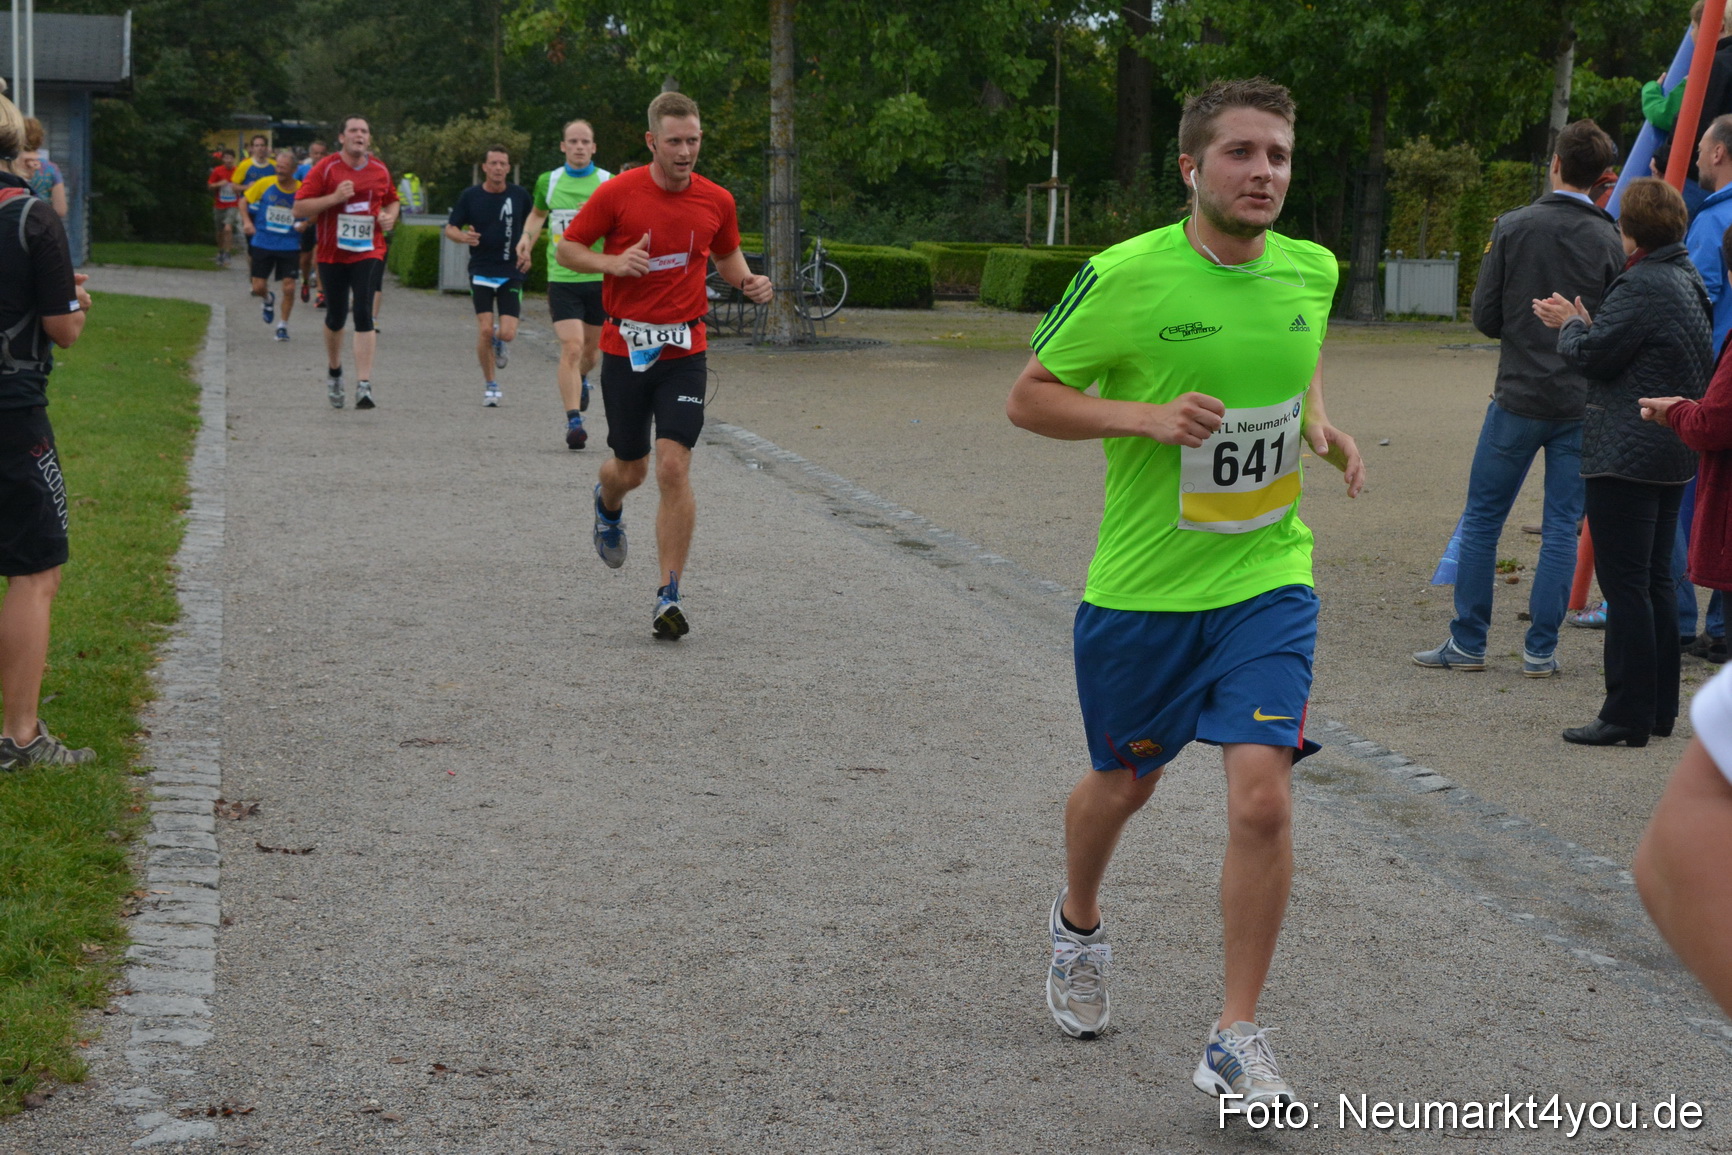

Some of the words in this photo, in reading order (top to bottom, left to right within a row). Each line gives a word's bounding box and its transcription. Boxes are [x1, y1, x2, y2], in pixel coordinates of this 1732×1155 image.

[342, 223, 371, 238] 2194
[1169, 321, 1203, 334] BERG
[627, 329, 684, 347] 2180
[677, 395, 703, 404] 2XU
[1237, 412, 1291, 433] Neumarkt
[1212, 431, 1285, 486] 641
